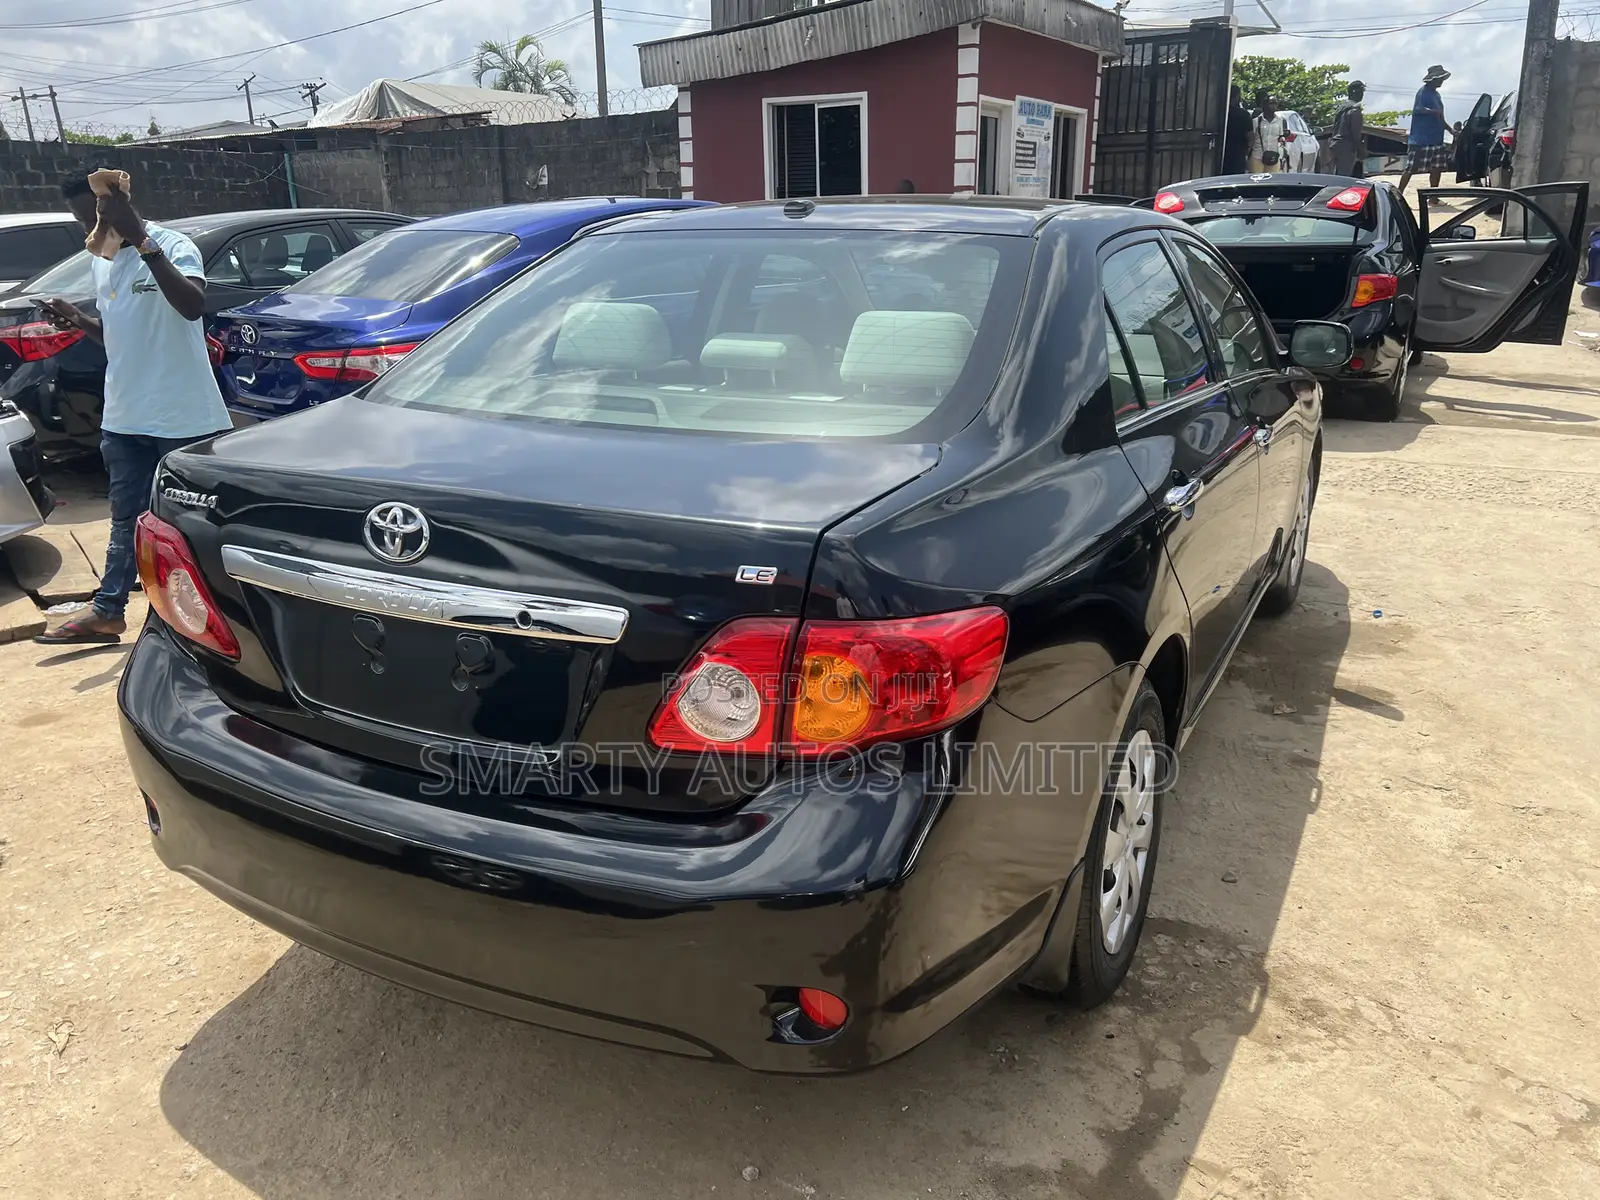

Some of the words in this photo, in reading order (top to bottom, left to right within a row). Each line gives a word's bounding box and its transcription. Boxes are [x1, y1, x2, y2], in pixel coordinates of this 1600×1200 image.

[1018, 101, 1036, 117] AUTO
[164, 487, 219, 509] COROLLA
[735, 565, 779, 584] LE
